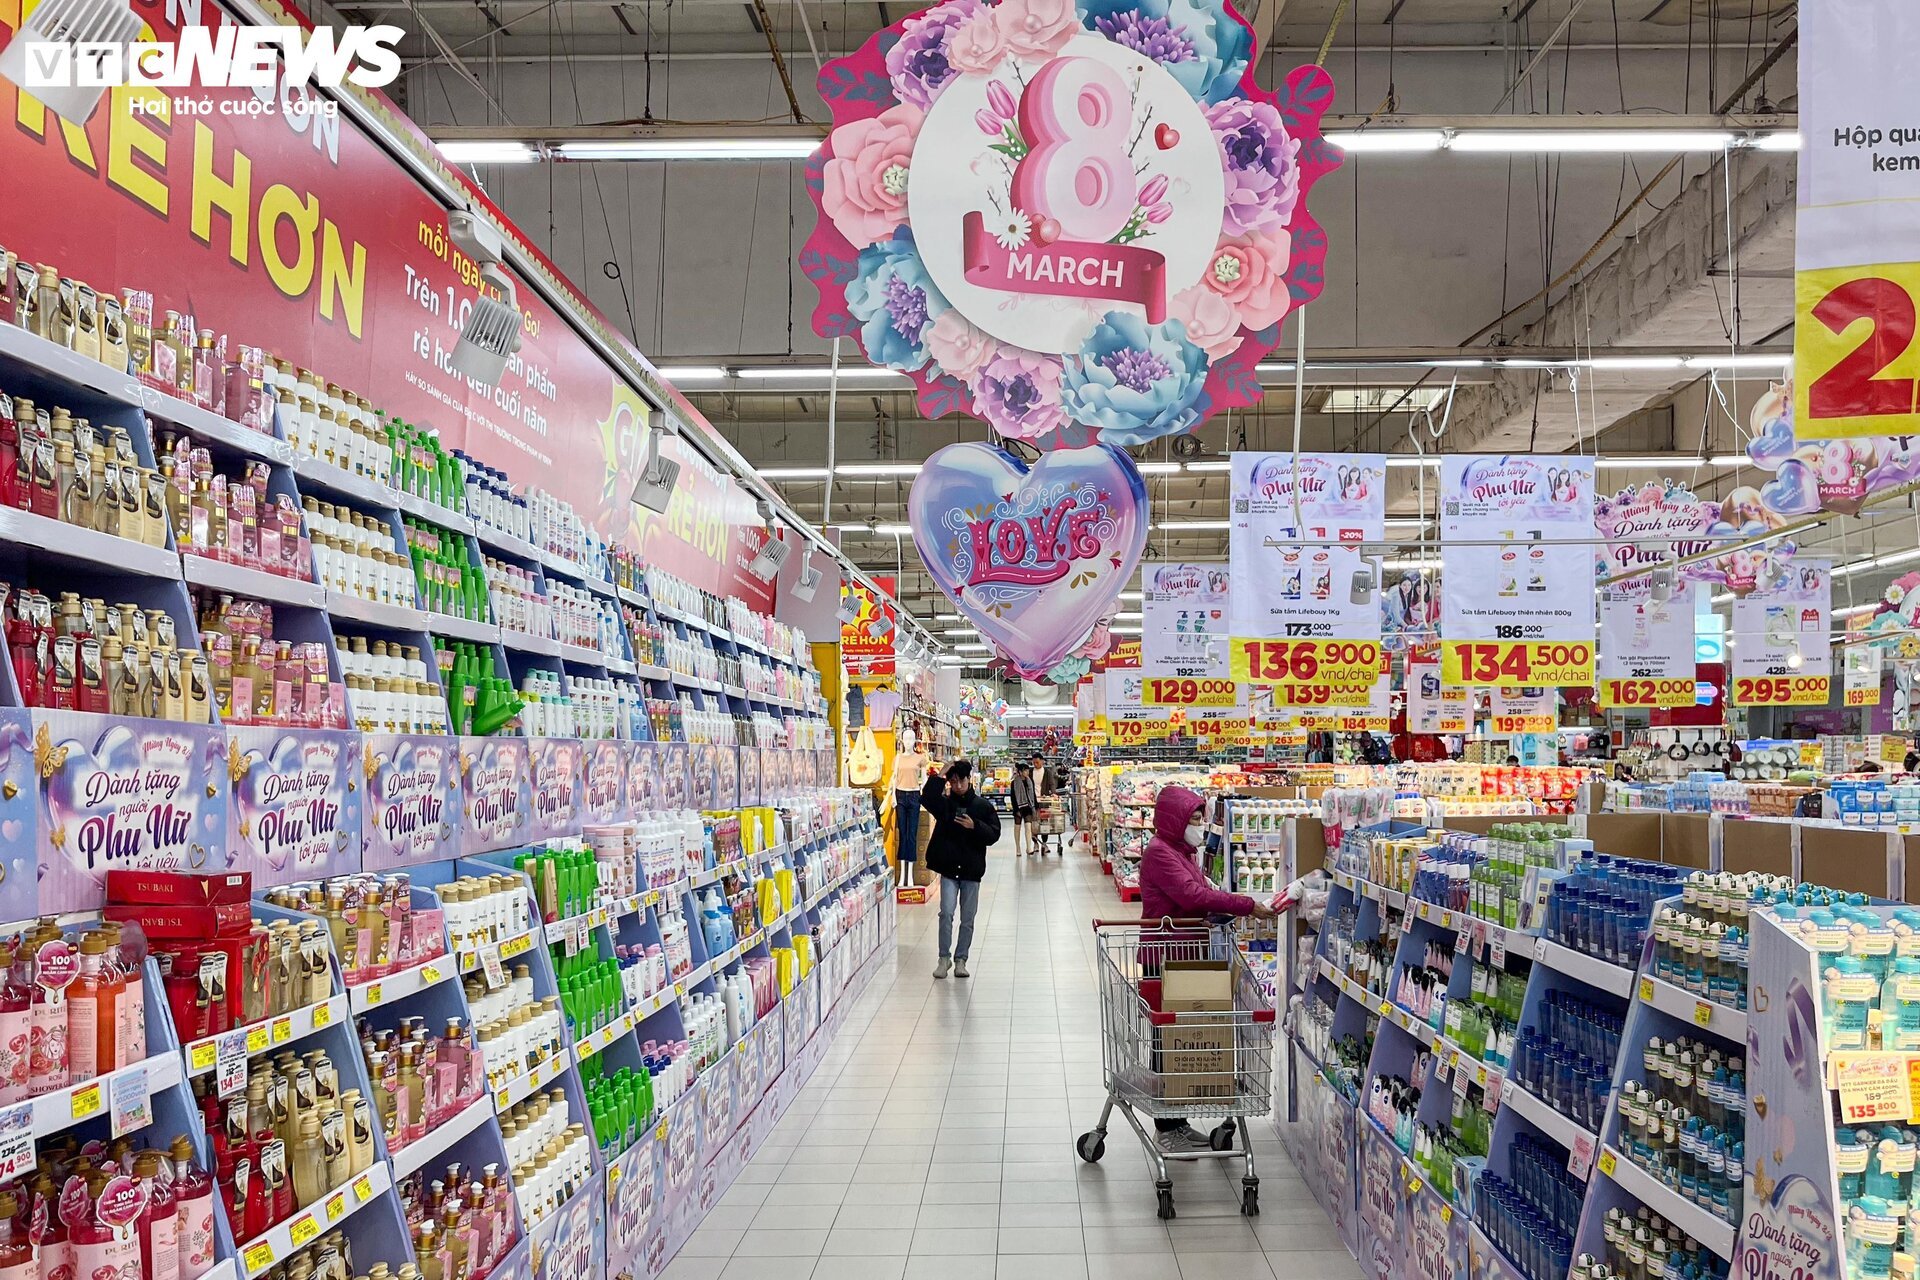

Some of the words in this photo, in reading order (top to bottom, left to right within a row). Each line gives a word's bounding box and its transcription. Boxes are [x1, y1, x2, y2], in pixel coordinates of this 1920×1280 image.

[1011, 55, 1140, 242] 8
[1834, 125, 1881, 149] Hộp
[1872, 153, 1919, 172] kem
[191, 118, 368, 341] HƠN
[419, 220, 448, 262] mỗi
[453, 250, 486, 296] ngày
[1006, 252, 1125, 288] MARCH
[404, 264, 440, 316] Trên
[524, 311, 541, 340] Go!
[413, 327, 430, 360] rẻ
[526, 363, 556, 402] phẩm
[495, 390, 521, 418] cuối
[523, 405, 547, 437] năm
[1299, 477, 1326, 493] Nữ
[1472, 483, 1506, 503] Phụ
[1509, 479, 1536, 496] Nữ
[1819, 486, 1857, 495] MARCH
[1682, 504, 1699, 518] 8/3
[1340, 532, 1362, 540] -20%
[1614, 517, 1666, 538] Dành
[1667, 515, 1703, 532] tặng
[967, 497, 1101, 586] LOVE
[1733, 577, 1754, 585] MARCH
[1298, 608, 1326, 616] Lifebouy
[1487, 609, 1516, 617] Lifebuoy
[1284, 623, 1331, 637] 173.000
[1494, 625, 1542, 639] 186.000
[1243, 641, 1376, 681] 136.900
[1454, 643, 1589, 682] 134.500
[1321, 667, 1375, 681] vnd/chai
[1533, 668, 1590, 683] vnd/chai
[1150, 680, 1235, 704] 129.000
[1199, 695, 1234, 705] vnd/chai
[1609, 680, 1695, 704] 162.000
[1737, 678, 1829, 703] 295.000
[1847, 689, 1879, 705] 169.000
[1111, 720, 1168, 736] 170.900
[1190, 720, 1247, 735] 194.900
[85, 769, 142, 808] Dành
[145, 769, 181, 800] tặng
[263, 771, 303, 804] Dành
[305, 771, 330, 796] tặng
[388, 770, 416, 799] Dành
[417, 769, 436, 792] tặng
[119, 798, 150, 822] người
[287, 796, 309, 816] người
[384, 801, 417, 841] Phụ
[418, 793, 443, 828] Nữ
[474, 797, 499, 829] Phụ
[500, 786, 517, 815] Nữ
[78, 812, 142, 870] Phụ
[145, 802, 192, 850] Nữ
[258, 807, 304, 855] Phụ
[306, 797, 338, 837] Nữ
[299, 843, 311, 862] tôi
[311, 837, 330, 865] yêu
[413, 832, 423, 849] tôi
[423, 828, 436, 850] yêu
[137, 882, 174, 893] TSUBAKI
[30, 1083, 63, 1094] SHOWER
[1848, 1102, 1897, 1119] 135.800
[1748, 1212, 1787, 1247] Dành
[1789, 1232, 1821, 1268] tặng
[1770, 1251, 1795, 1269] người
